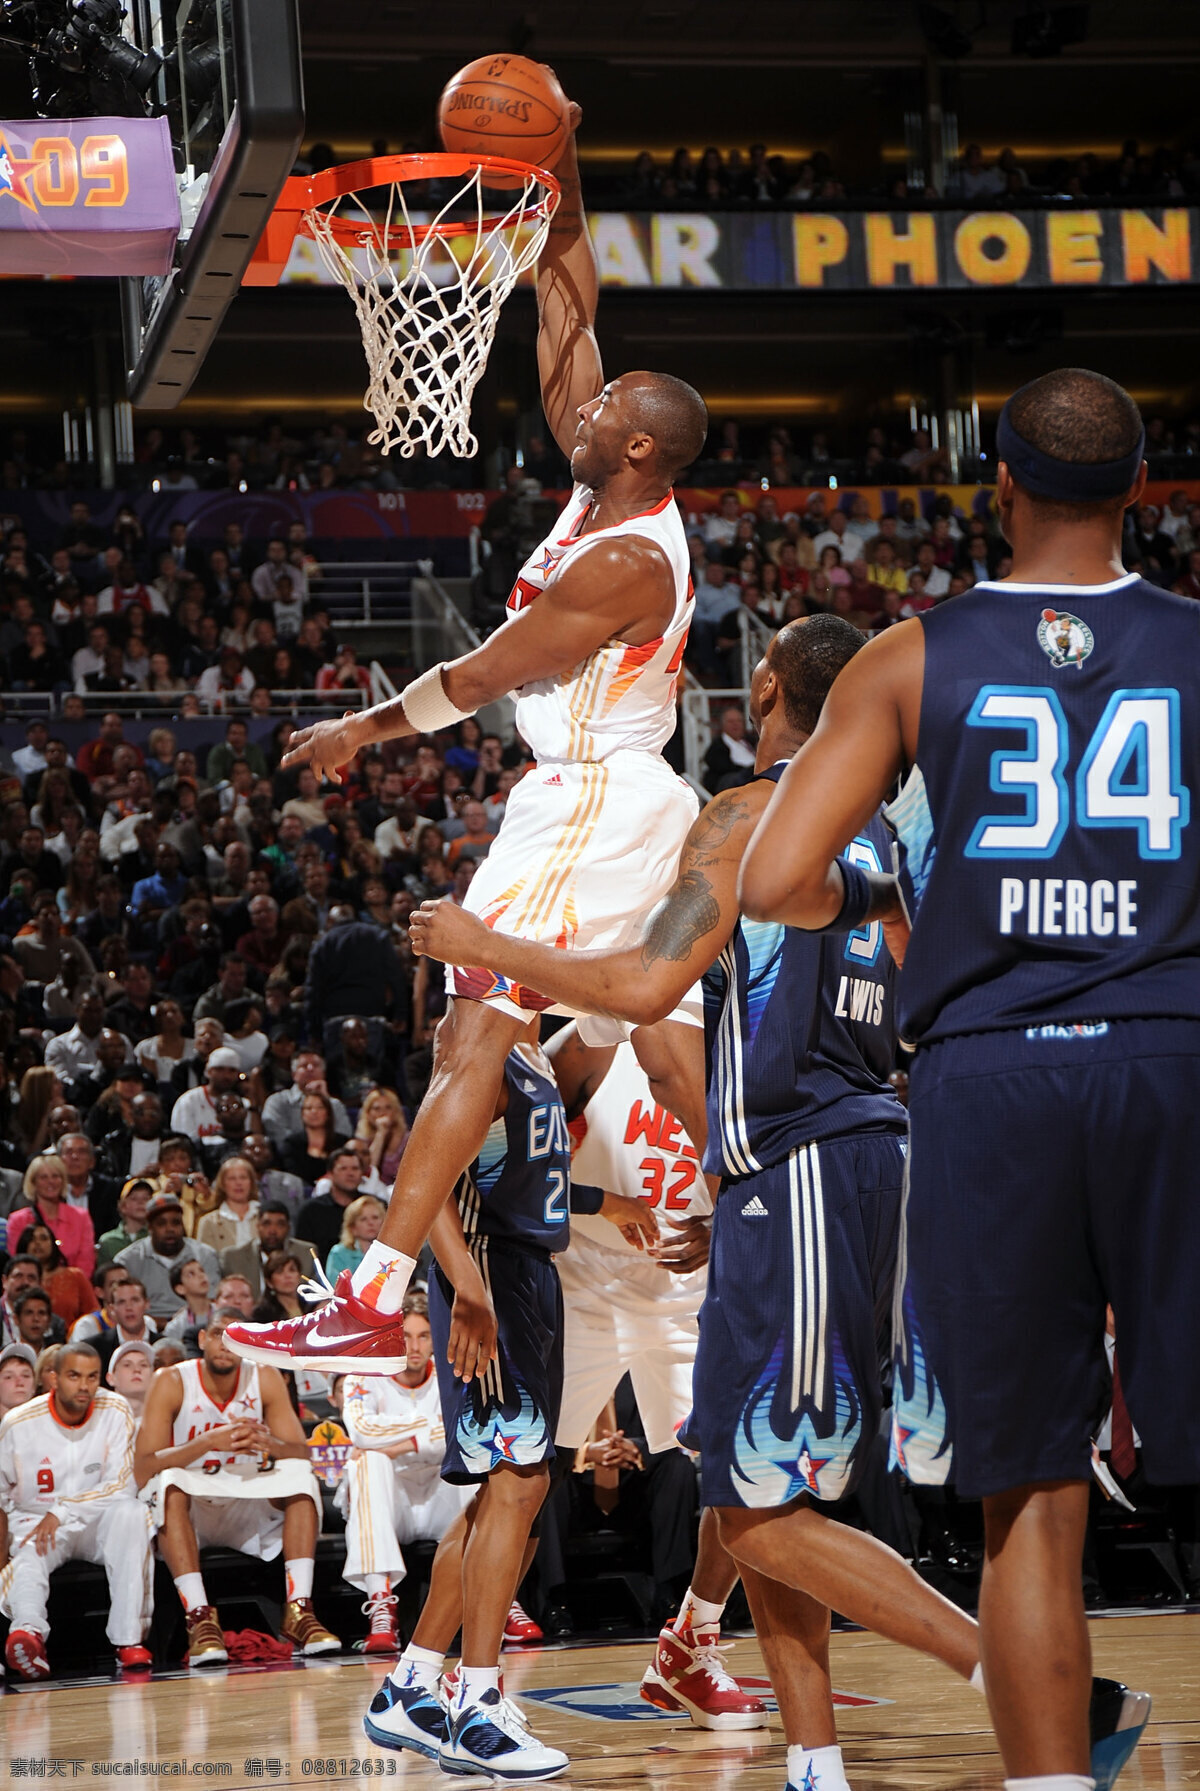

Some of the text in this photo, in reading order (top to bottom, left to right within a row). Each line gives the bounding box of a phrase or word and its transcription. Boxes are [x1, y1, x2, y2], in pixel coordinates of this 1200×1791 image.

[448, 92, 532, 123] SPALDING
[32, 135, 129, 206] 09
[793, 209, 1192, 288] PHOEN
[377, 493, 406, 511] 101
[457, 493, 485, 511] 102
[964, 685, 1190, 860] 34
[1000, 878, 1138, 937] PIERCE
[834, 974, 885, 1026] LWIS
[637, 1157, 697, 1210] 32
[741, 1208, 768, 1216] adidas
[37, 1468, 55, 1494] 9
